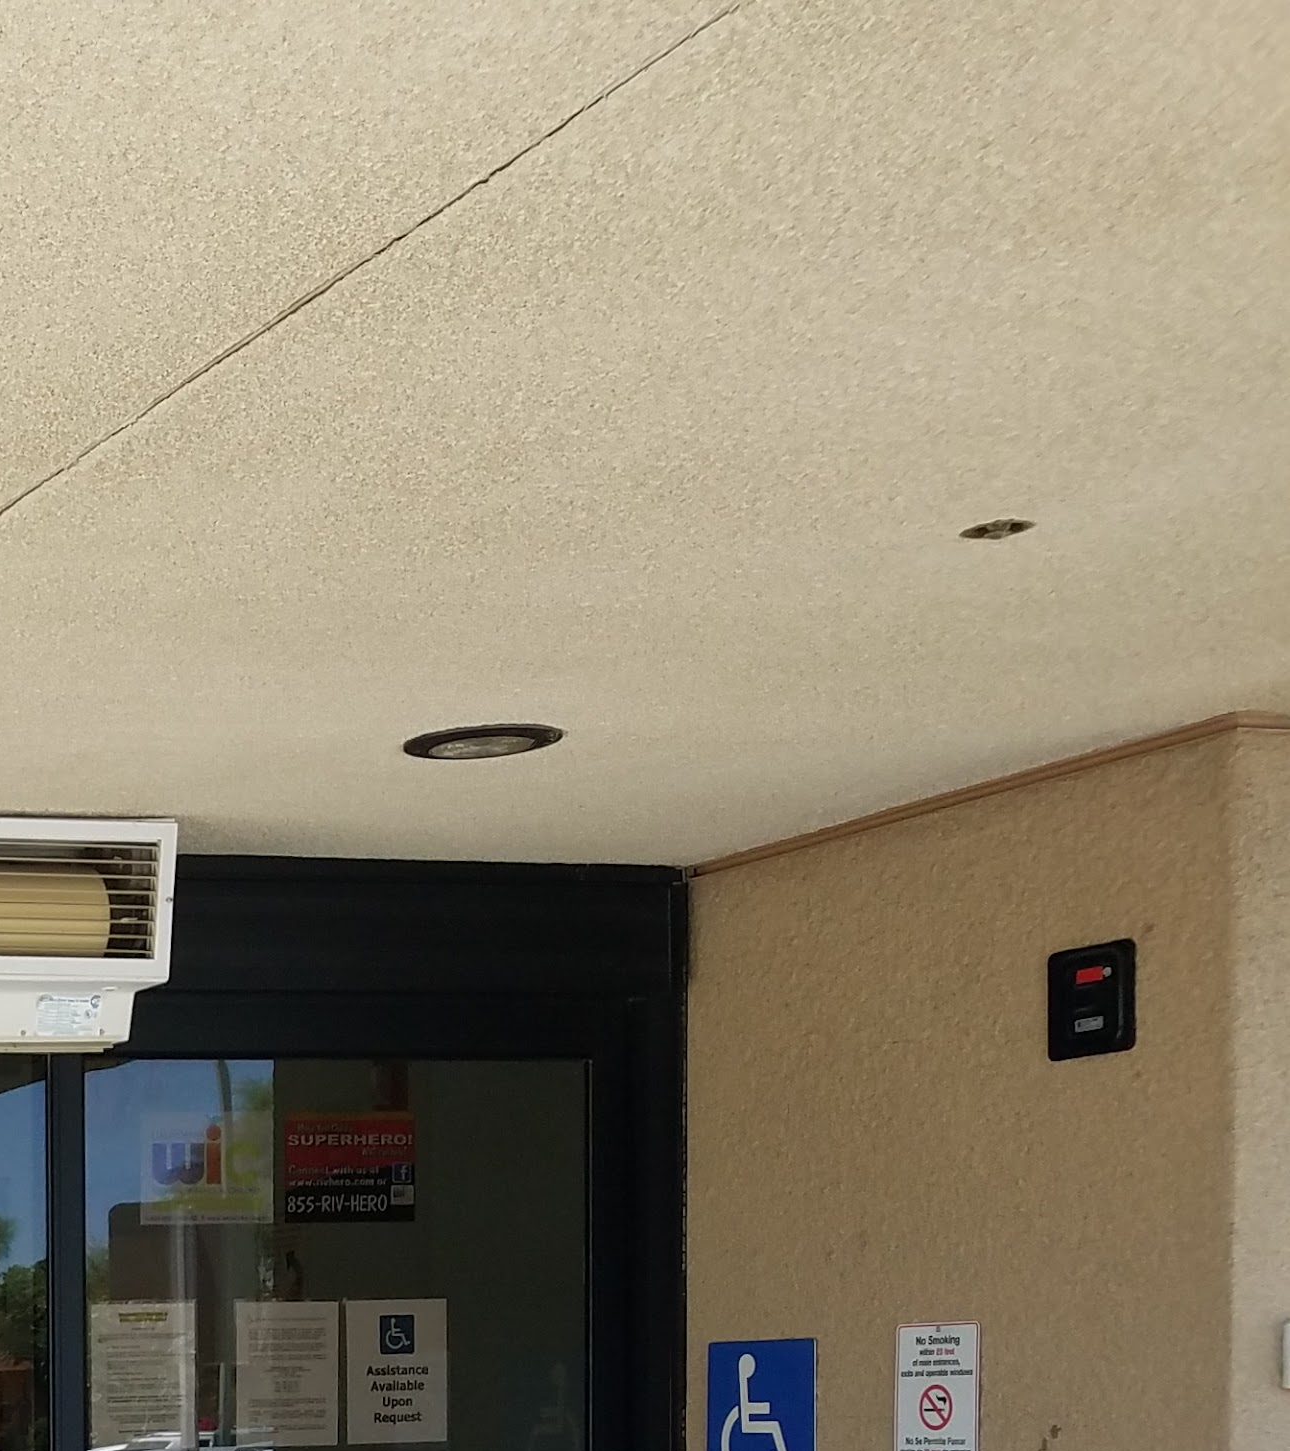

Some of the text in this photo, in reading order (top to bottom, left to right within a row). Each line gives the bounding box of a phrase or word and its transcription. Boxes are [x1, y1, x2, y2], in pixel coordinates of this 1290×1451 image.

[288, 1134, 413, 1146] SUPERHERO!
[287, 1194, 388, 1213] 855-RIV-HERO
[915, 1335, 960, 1346] No Smoking
[366, 1365, 429, 1376] Assistance
[370, 1380, 425, 1392] Available
[382, 1397, 413, 1409] Upon
[374, 1412, 422, 1425] Request
